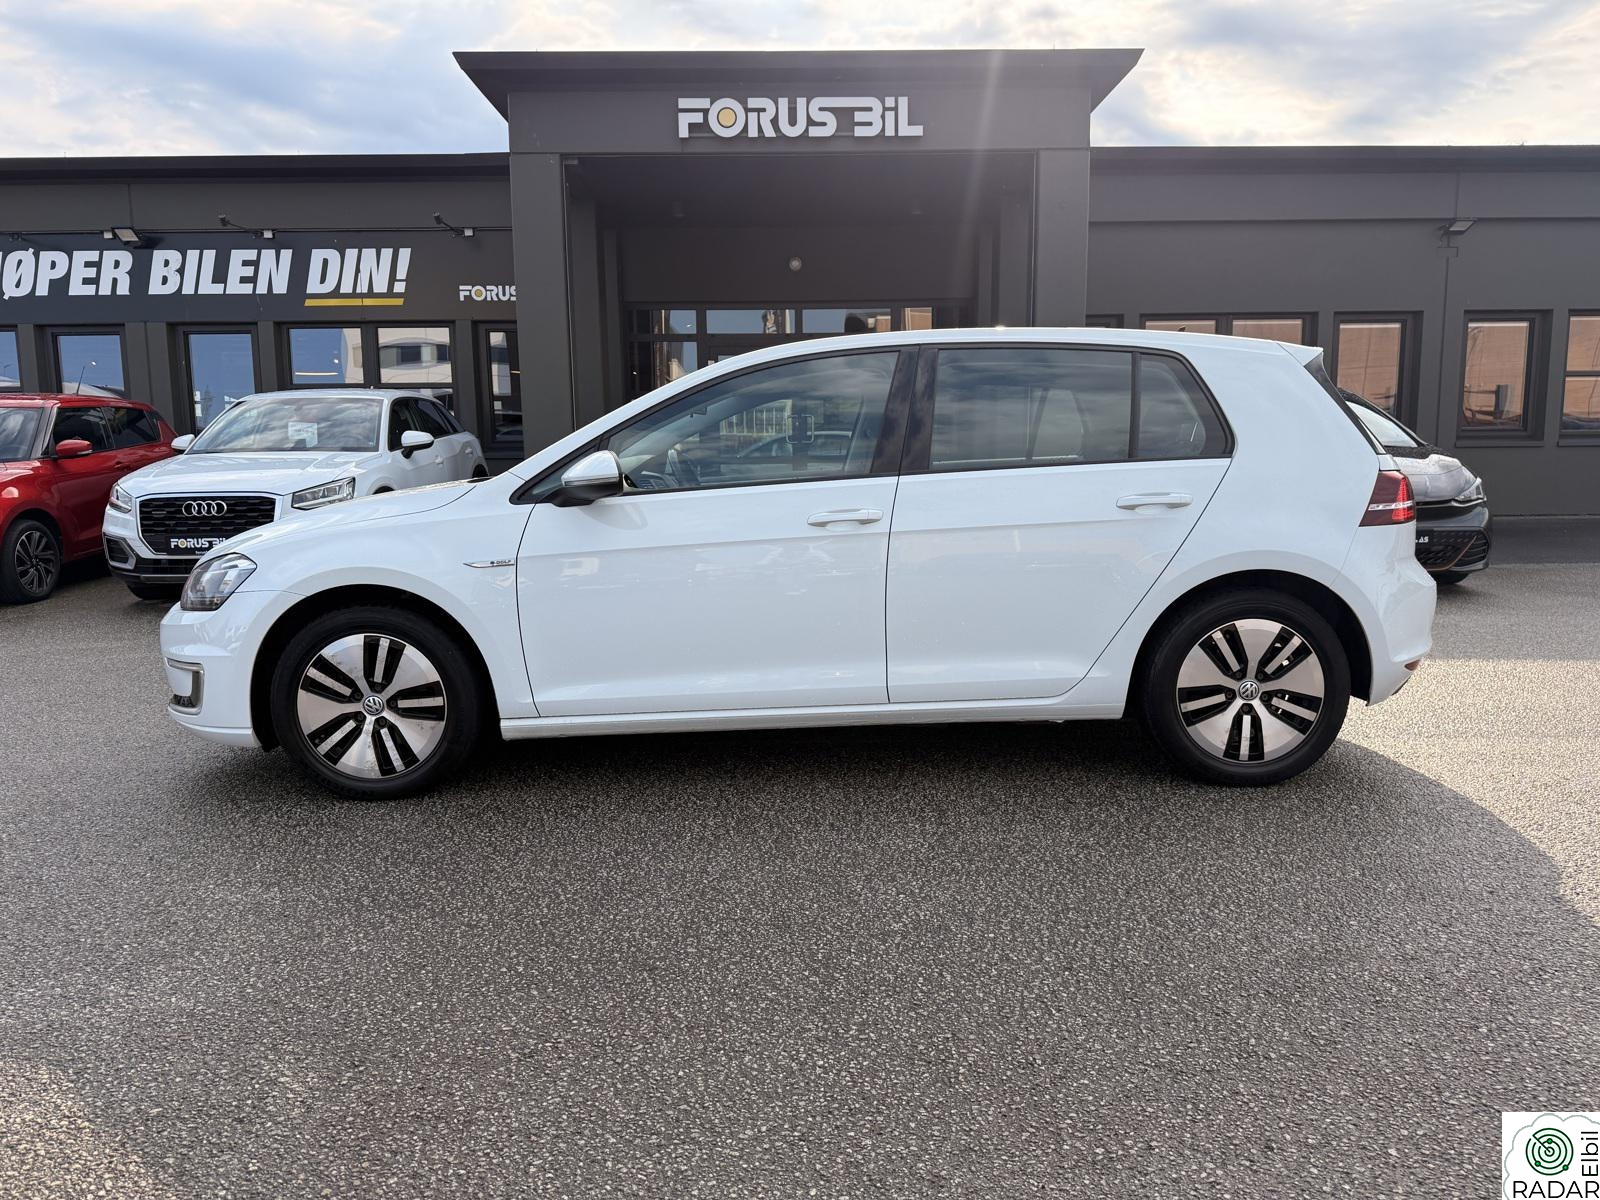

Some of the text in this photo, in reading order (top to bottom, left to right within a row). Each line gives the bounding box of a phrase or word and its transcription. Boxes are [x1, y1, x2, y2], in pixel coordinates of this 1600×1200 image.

[678, 97, 837, 138] FORUS
[0, 247, 412, 300] ØPER BILEN DIN!
[170, 538, 209, 548] FORUS
